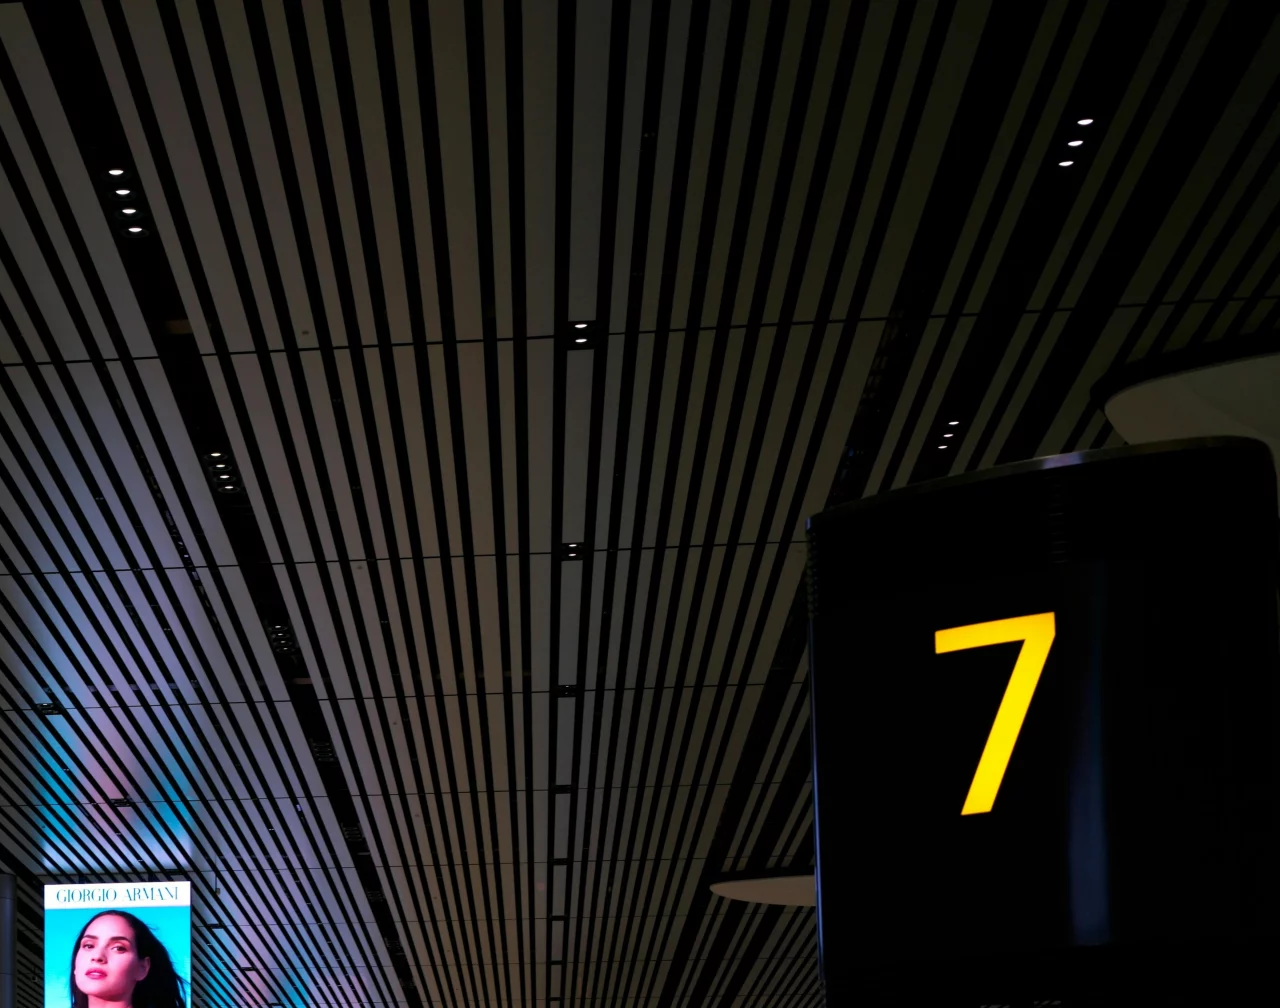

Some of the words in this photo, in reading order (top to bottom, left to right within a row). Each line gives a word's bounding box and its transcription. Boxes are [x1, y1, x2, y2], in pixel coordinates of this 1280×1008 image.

[935, 611, 1056, 816] 7
[56, 888, 117, 903] GIORGIO
[122, 886, 179, 901] ARMANI
